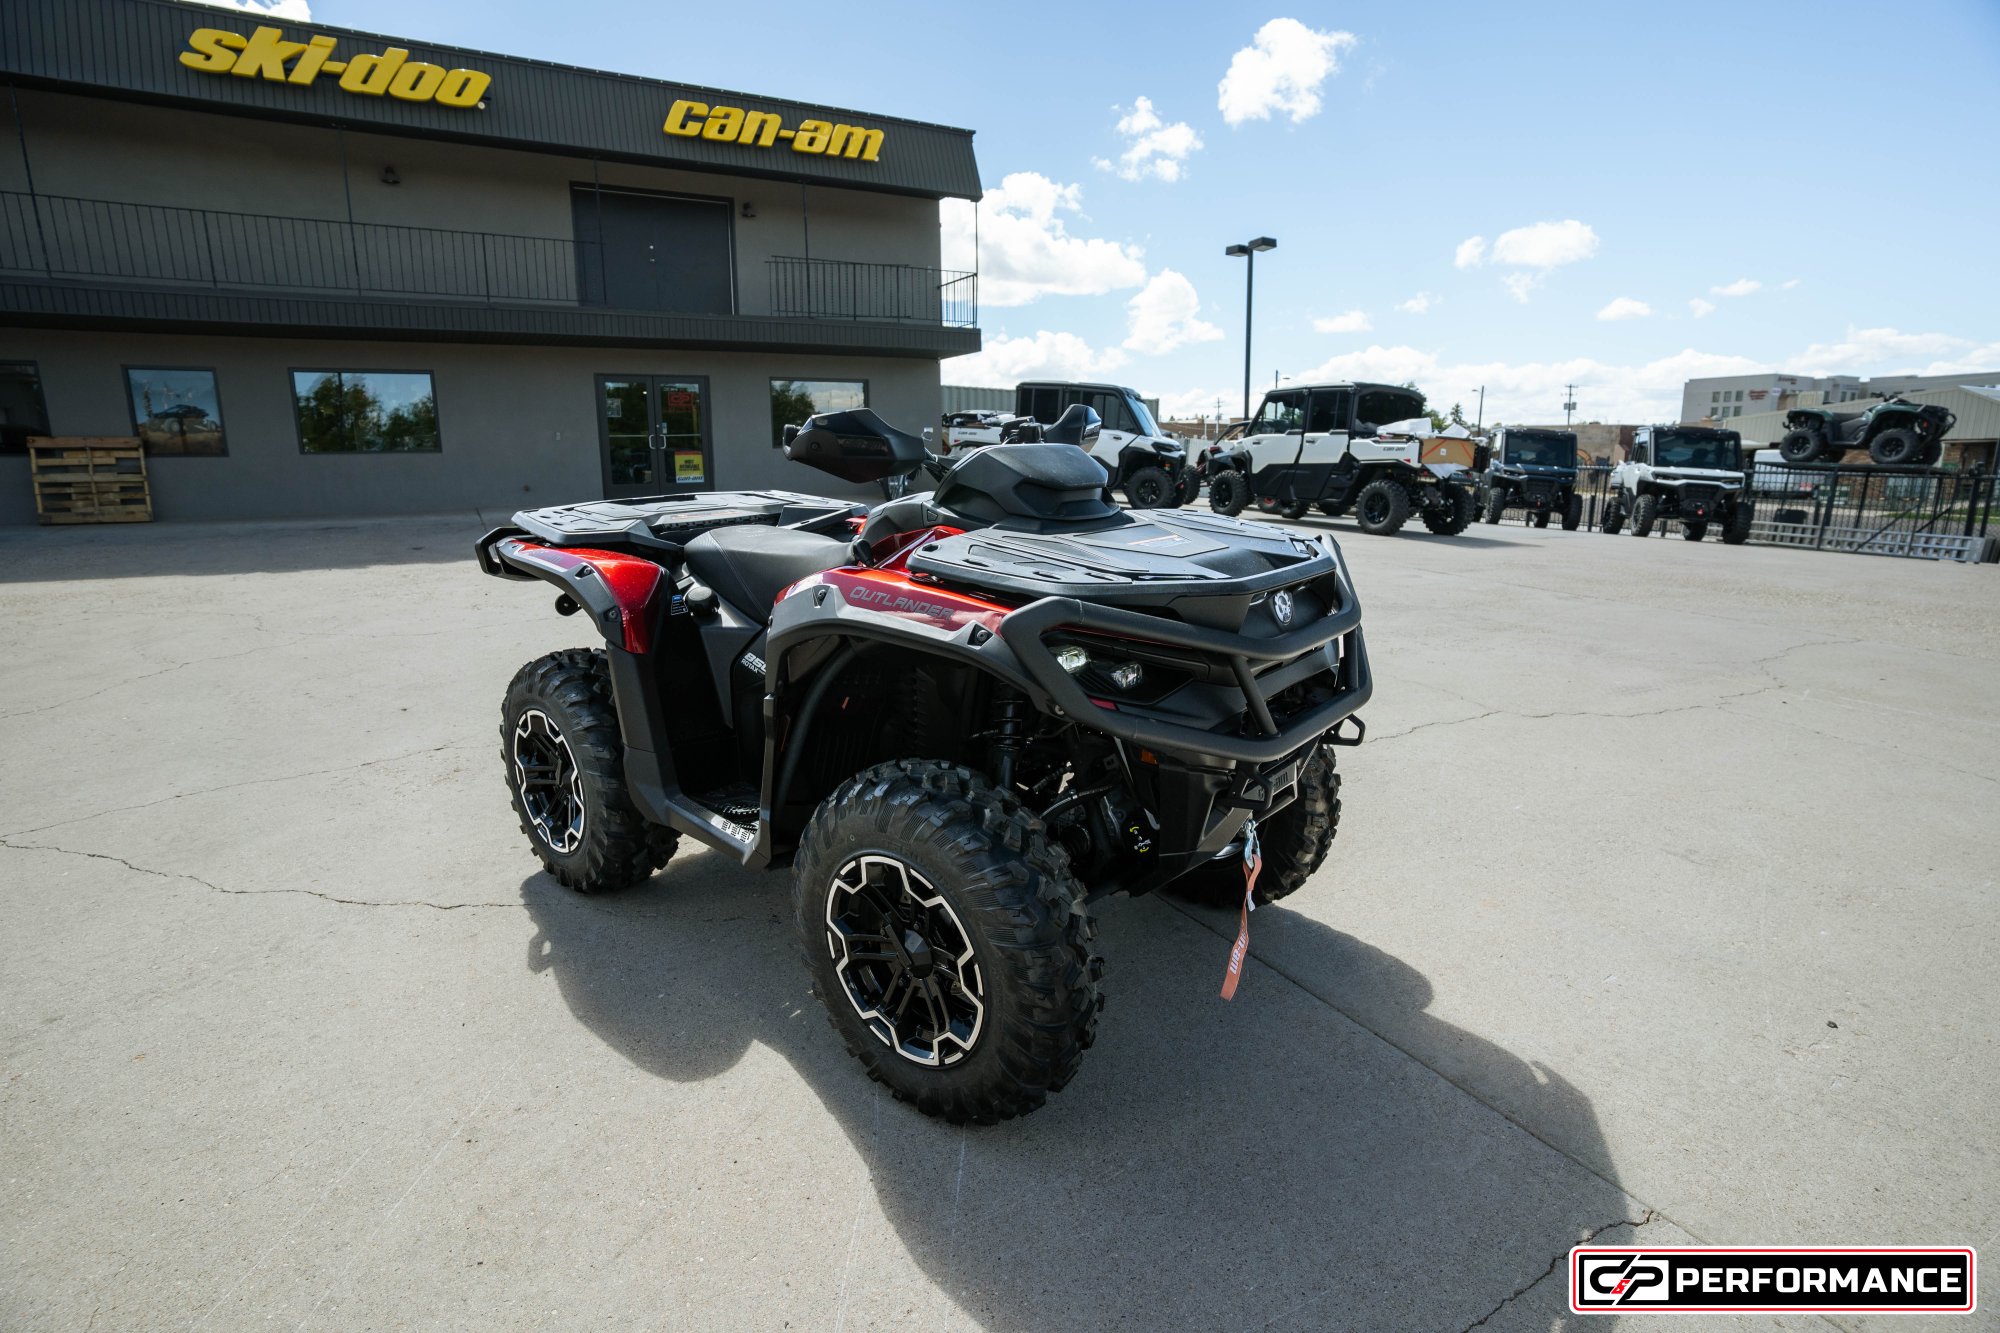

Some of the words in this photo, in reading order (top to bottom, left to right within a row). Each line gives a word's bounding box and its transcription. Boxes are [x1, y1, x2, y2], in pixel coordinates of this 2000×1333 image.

[179, 26, 491, 107] ski-doo
[663, 100, 884, 161] can-am
[850, 586, 955, 620] OUTLANDER
[740, 658, 759, 675] ROTAX
